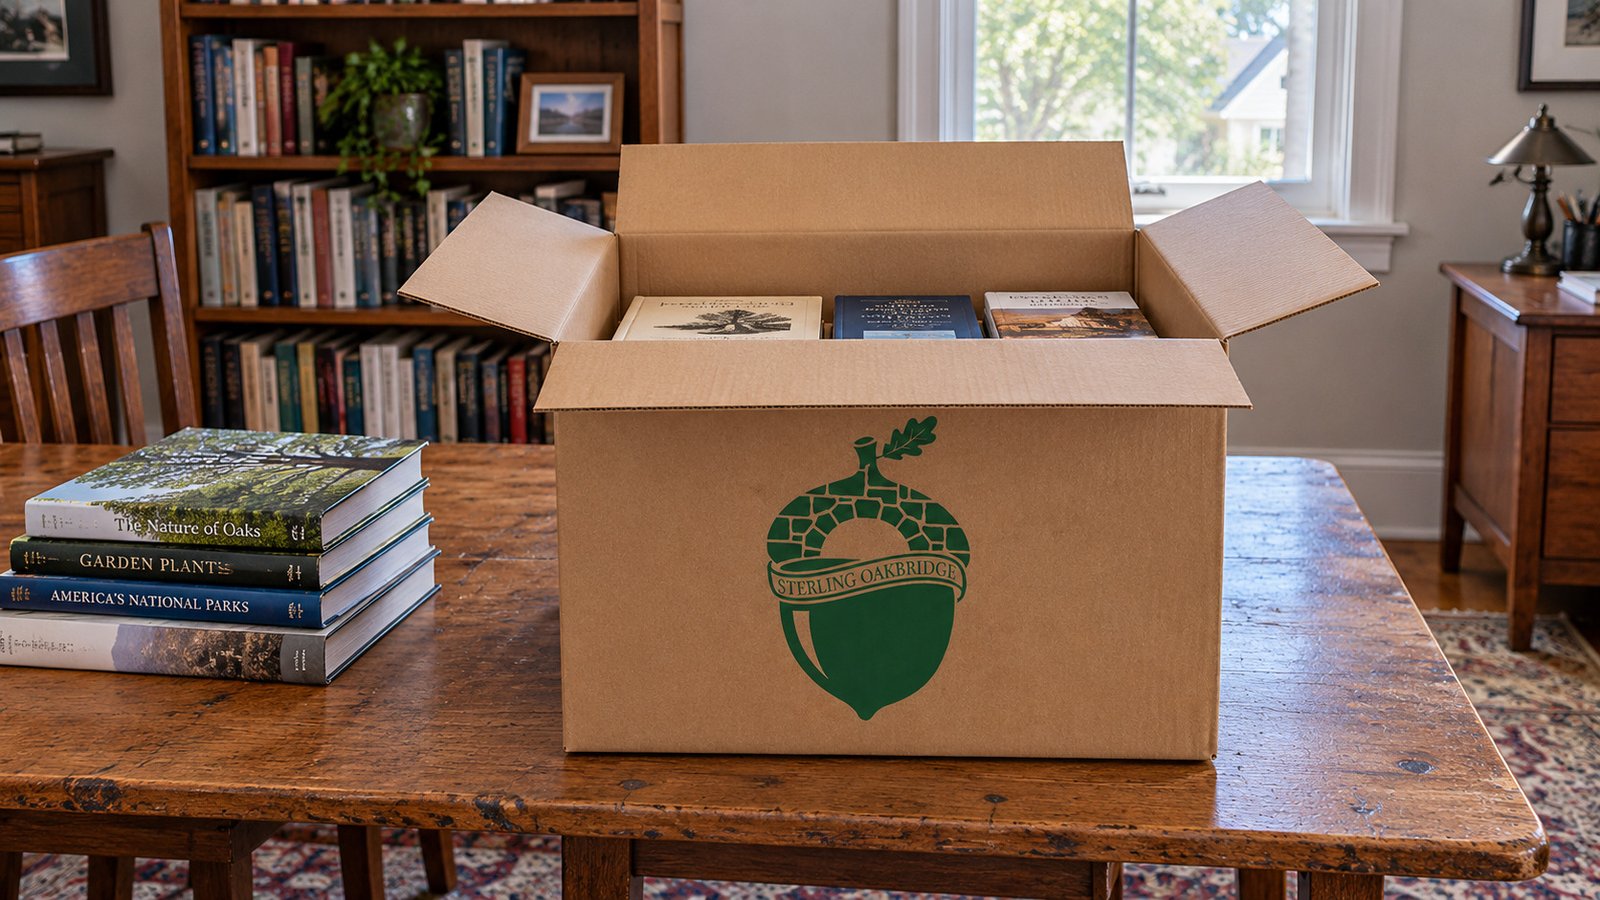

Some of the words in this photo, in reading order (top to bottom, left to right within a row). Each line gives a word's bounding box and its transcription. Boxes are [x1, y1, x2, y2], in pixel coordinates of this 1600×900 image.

[114, 517, 142, 532] The
[147, 519, 199, 535] Nature
[204, 521, 220, 536] of
[223, 522, 261, 538] Oaks
[79, 553, 153, 571] GARDEN
[777, 572, 857, 596] STERLING
[860, 560, 957, 583] OAKBRIDGE
[51, 590, 125, 606] AMERICA'S
[129, 594, 202, 611] NATIONAL
[206, 598, 249, 613] PARKS
